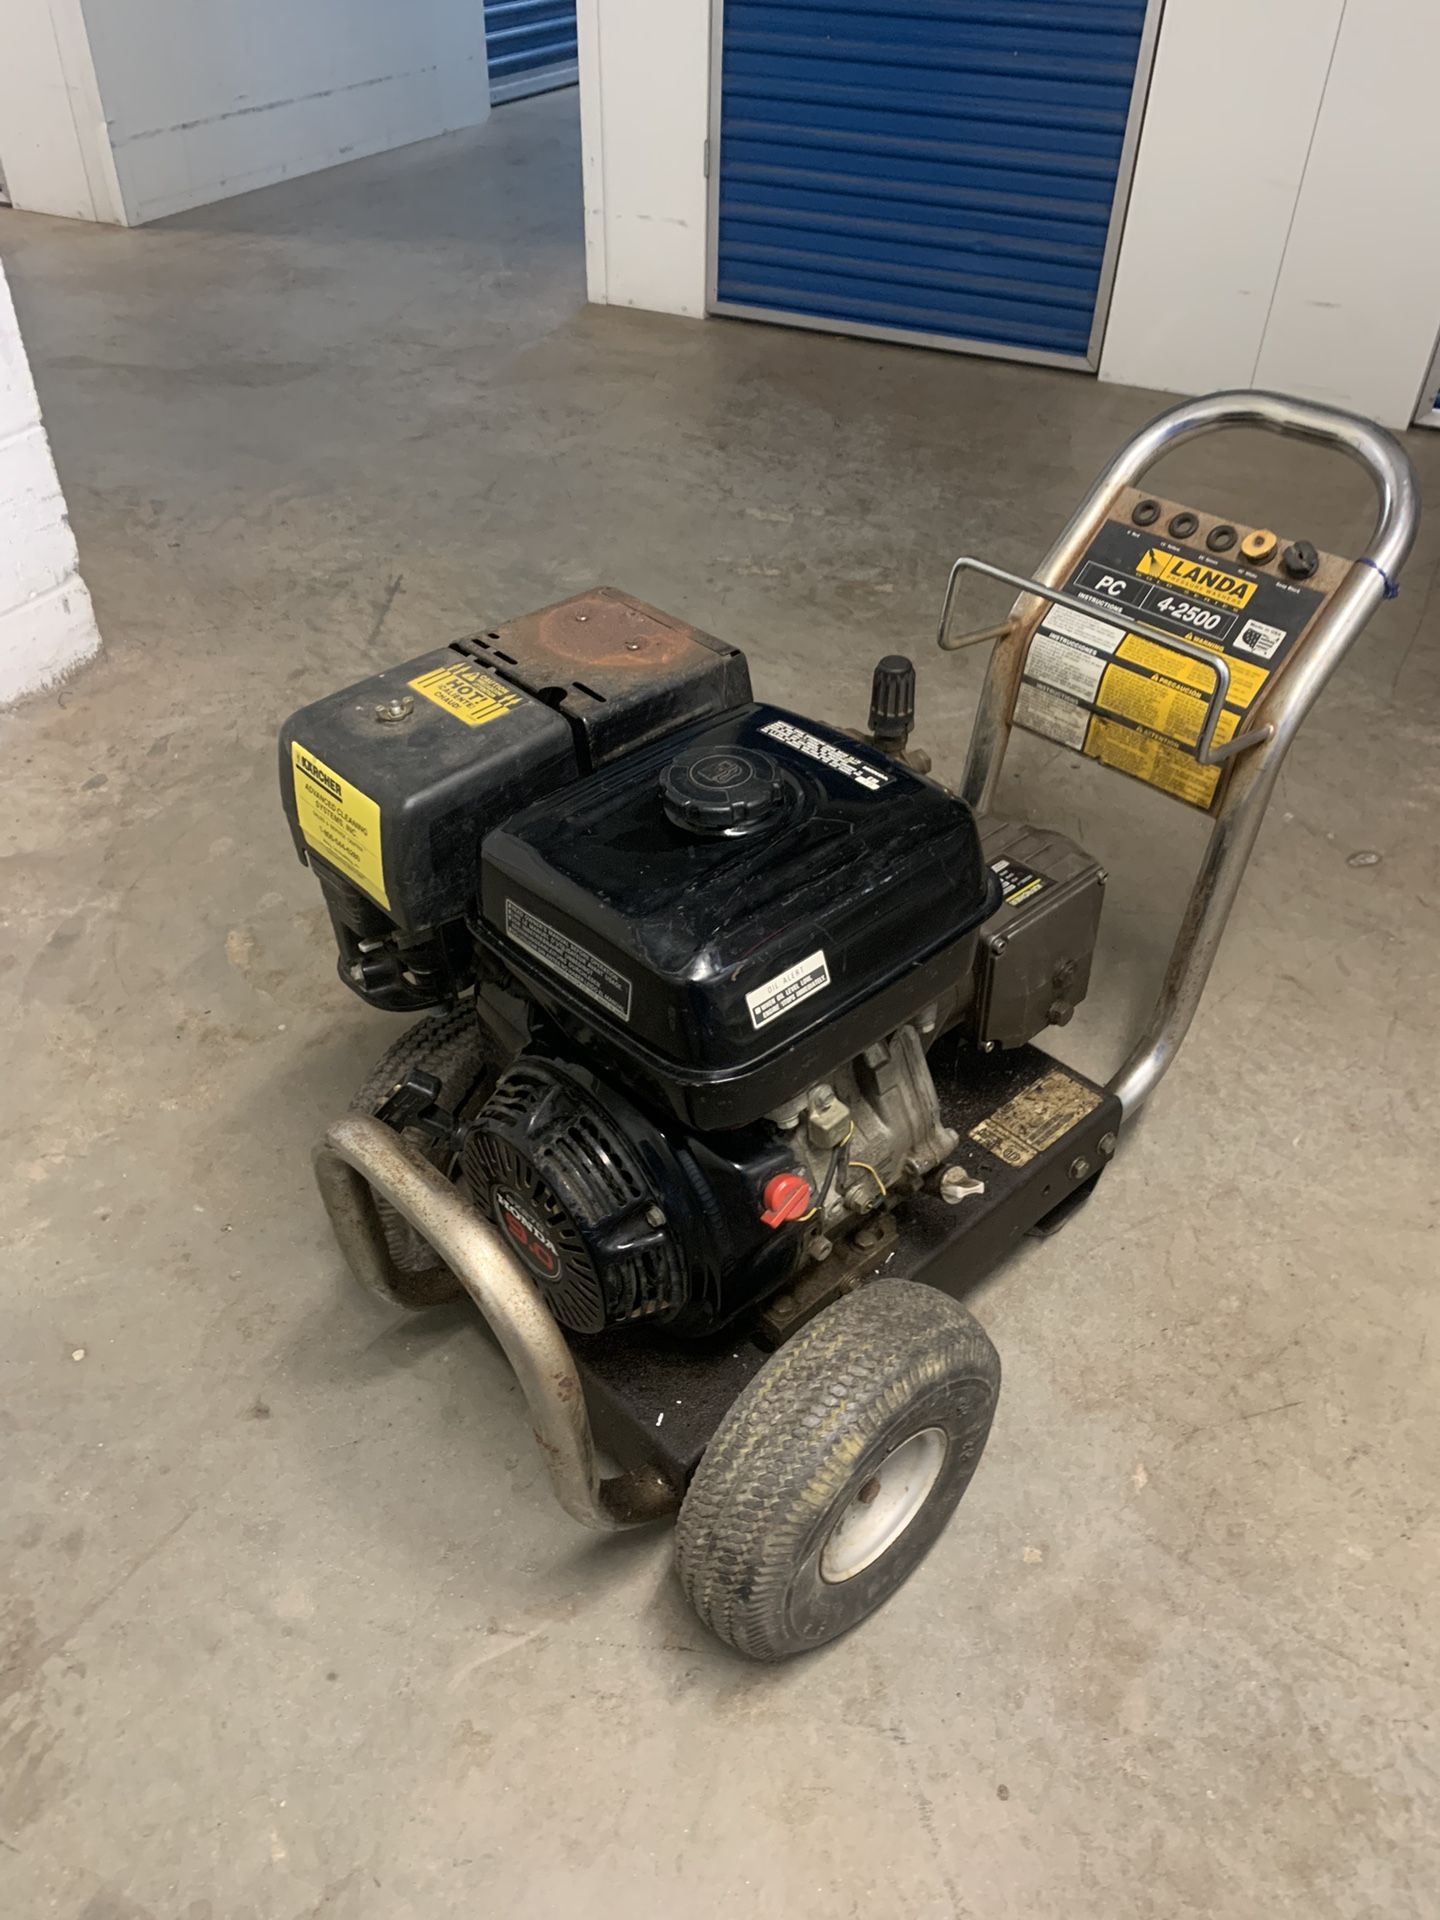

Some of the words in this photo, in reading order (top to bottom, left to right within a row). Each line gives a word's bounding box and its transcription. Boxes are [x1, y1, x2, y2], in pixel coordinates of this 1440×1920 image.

[1170, 560, 1249, 600] LANDA
[1078, 591, 1124, 613] INSTRUCTIONS
[1095, 574, 1127, 597] PC
[1156, 597, 1222, 631] 4-2500
[1049, 632, 1097, 656] INSTRUCCIONES
[1193, 635, 1226, 652] WARNING
[446, 679, 488, 704] HOT!
[304, 782, 337, 812] ADVANCED
[336, 807, 369, 837] CLEANING
[767, 983, 779, 995] OIL
[782, 966, 804, 985] ALERT
[496, 1191, 559, 1257] HONDA
